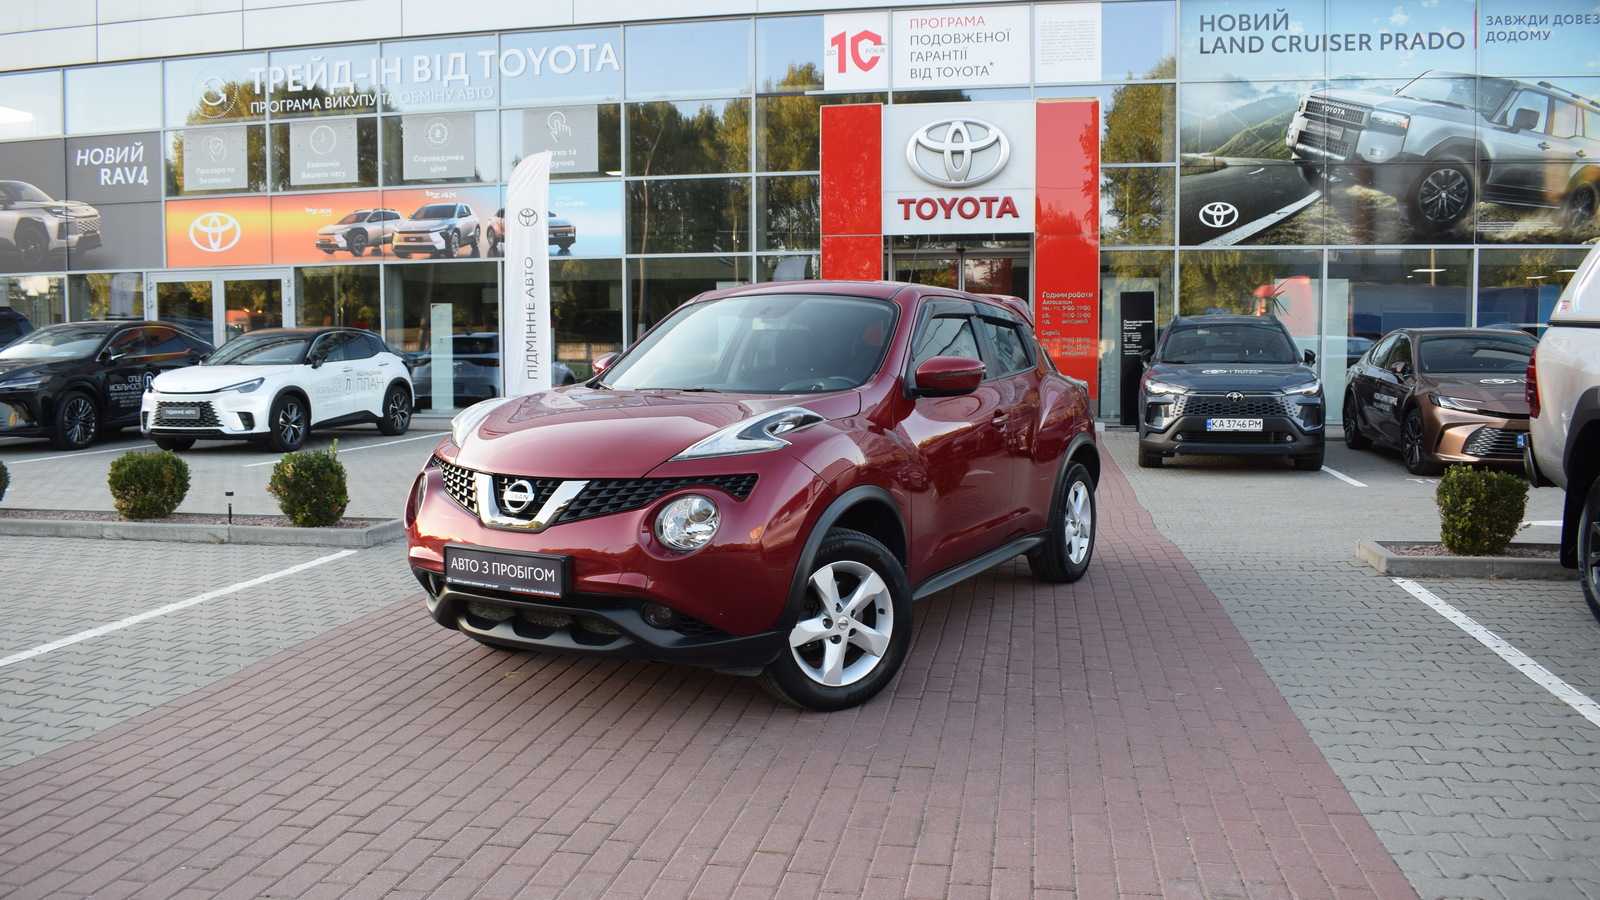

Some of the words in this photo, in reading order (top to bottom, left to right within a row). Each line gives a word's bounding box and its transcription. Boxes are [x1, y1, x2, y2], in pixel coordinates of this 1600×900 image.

[910, 16, 986, 29] ПРОГРАМА
[1200, 8, 1289, 32] НОВИЙ
[1486, 15, 1549, 27] ЗАВЖДИ
[910, 28, 1011, 47] ПОДОВЖЕНОЇ
[1200, 36, 1264, 54] LAND
[1271, 34, 1372, 53] CRUISER
[1380, 31, 1465, 50] PRADO
[1485, 31, 1551, 43] ДОДОМУ
[910, 47, 968, 62] ГАРАНТІЇ
[250, 55, 402, 95] ТРЕЙД-ІН
[413, 52, 471, 87] ВІД
[478, 42, 621, 79] TOYOTA
[910, 67, 932, 80] ВІД
[250, 97, 322, 114] ПРОГРАМА
[324, 93, 378, 109] ВИКУПУ
[381, 92, 395, 105] ТА
[400, 88, 455, 104] ОБМІНУ
[458, 86, 494, 100] АВТО
[1321, 105, 1345, 115] TOYOTA
[76, 142, 144, 166] НОВИЙ
[413, 154, 464, 163] Справедлива
[195, 167, 226, 176] Прозоро
[430, 166, 447, 174] ціна
[550, 160, 575, 168] ручно
[100, 165, 149, 185] RAV4
[898, 196, 1019, 220] TOYOTA
[525, 257, 535, 298] АВТО
[1042, 291, 1067, 299] Години
[1068, 291, 1093, 299] роботи
[526, 302, 539, 380] ПІДМІННЕ
[1211, 420, 1225, 428] KA
[1226, 420, 1247, 428] 3746
[1248, 420, 1262, 428] PM
[451, 557, 479, 573] АВТО
[492, 562, 555, 582] ПРОБІГОМ
